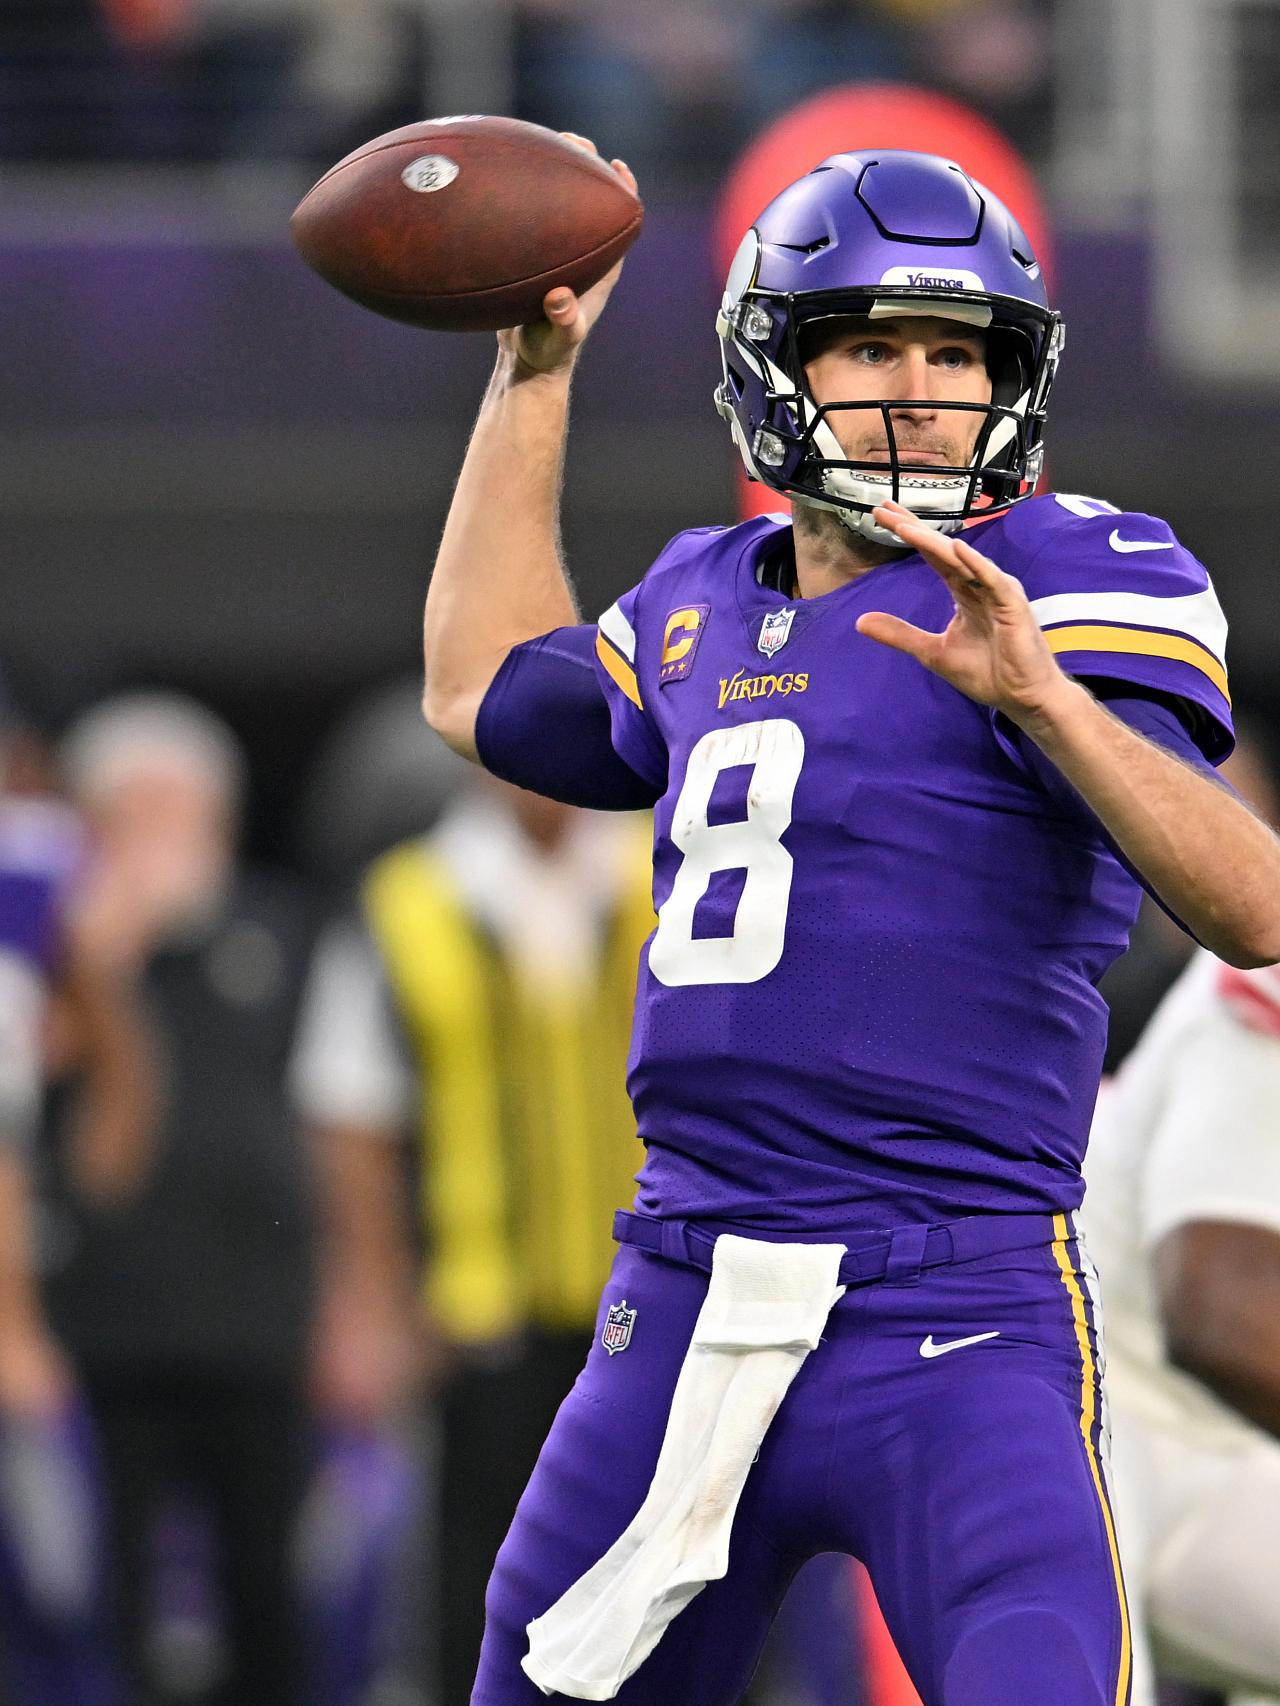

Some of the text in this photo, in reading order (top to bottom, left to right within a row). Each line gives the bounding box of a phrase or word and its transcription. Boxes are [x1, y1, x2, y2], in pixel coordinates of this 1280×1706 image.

[662, 609, 700, 664] C
[648, 719, 804, 986] 8
[606, 1325, 625, 1345] NFL
